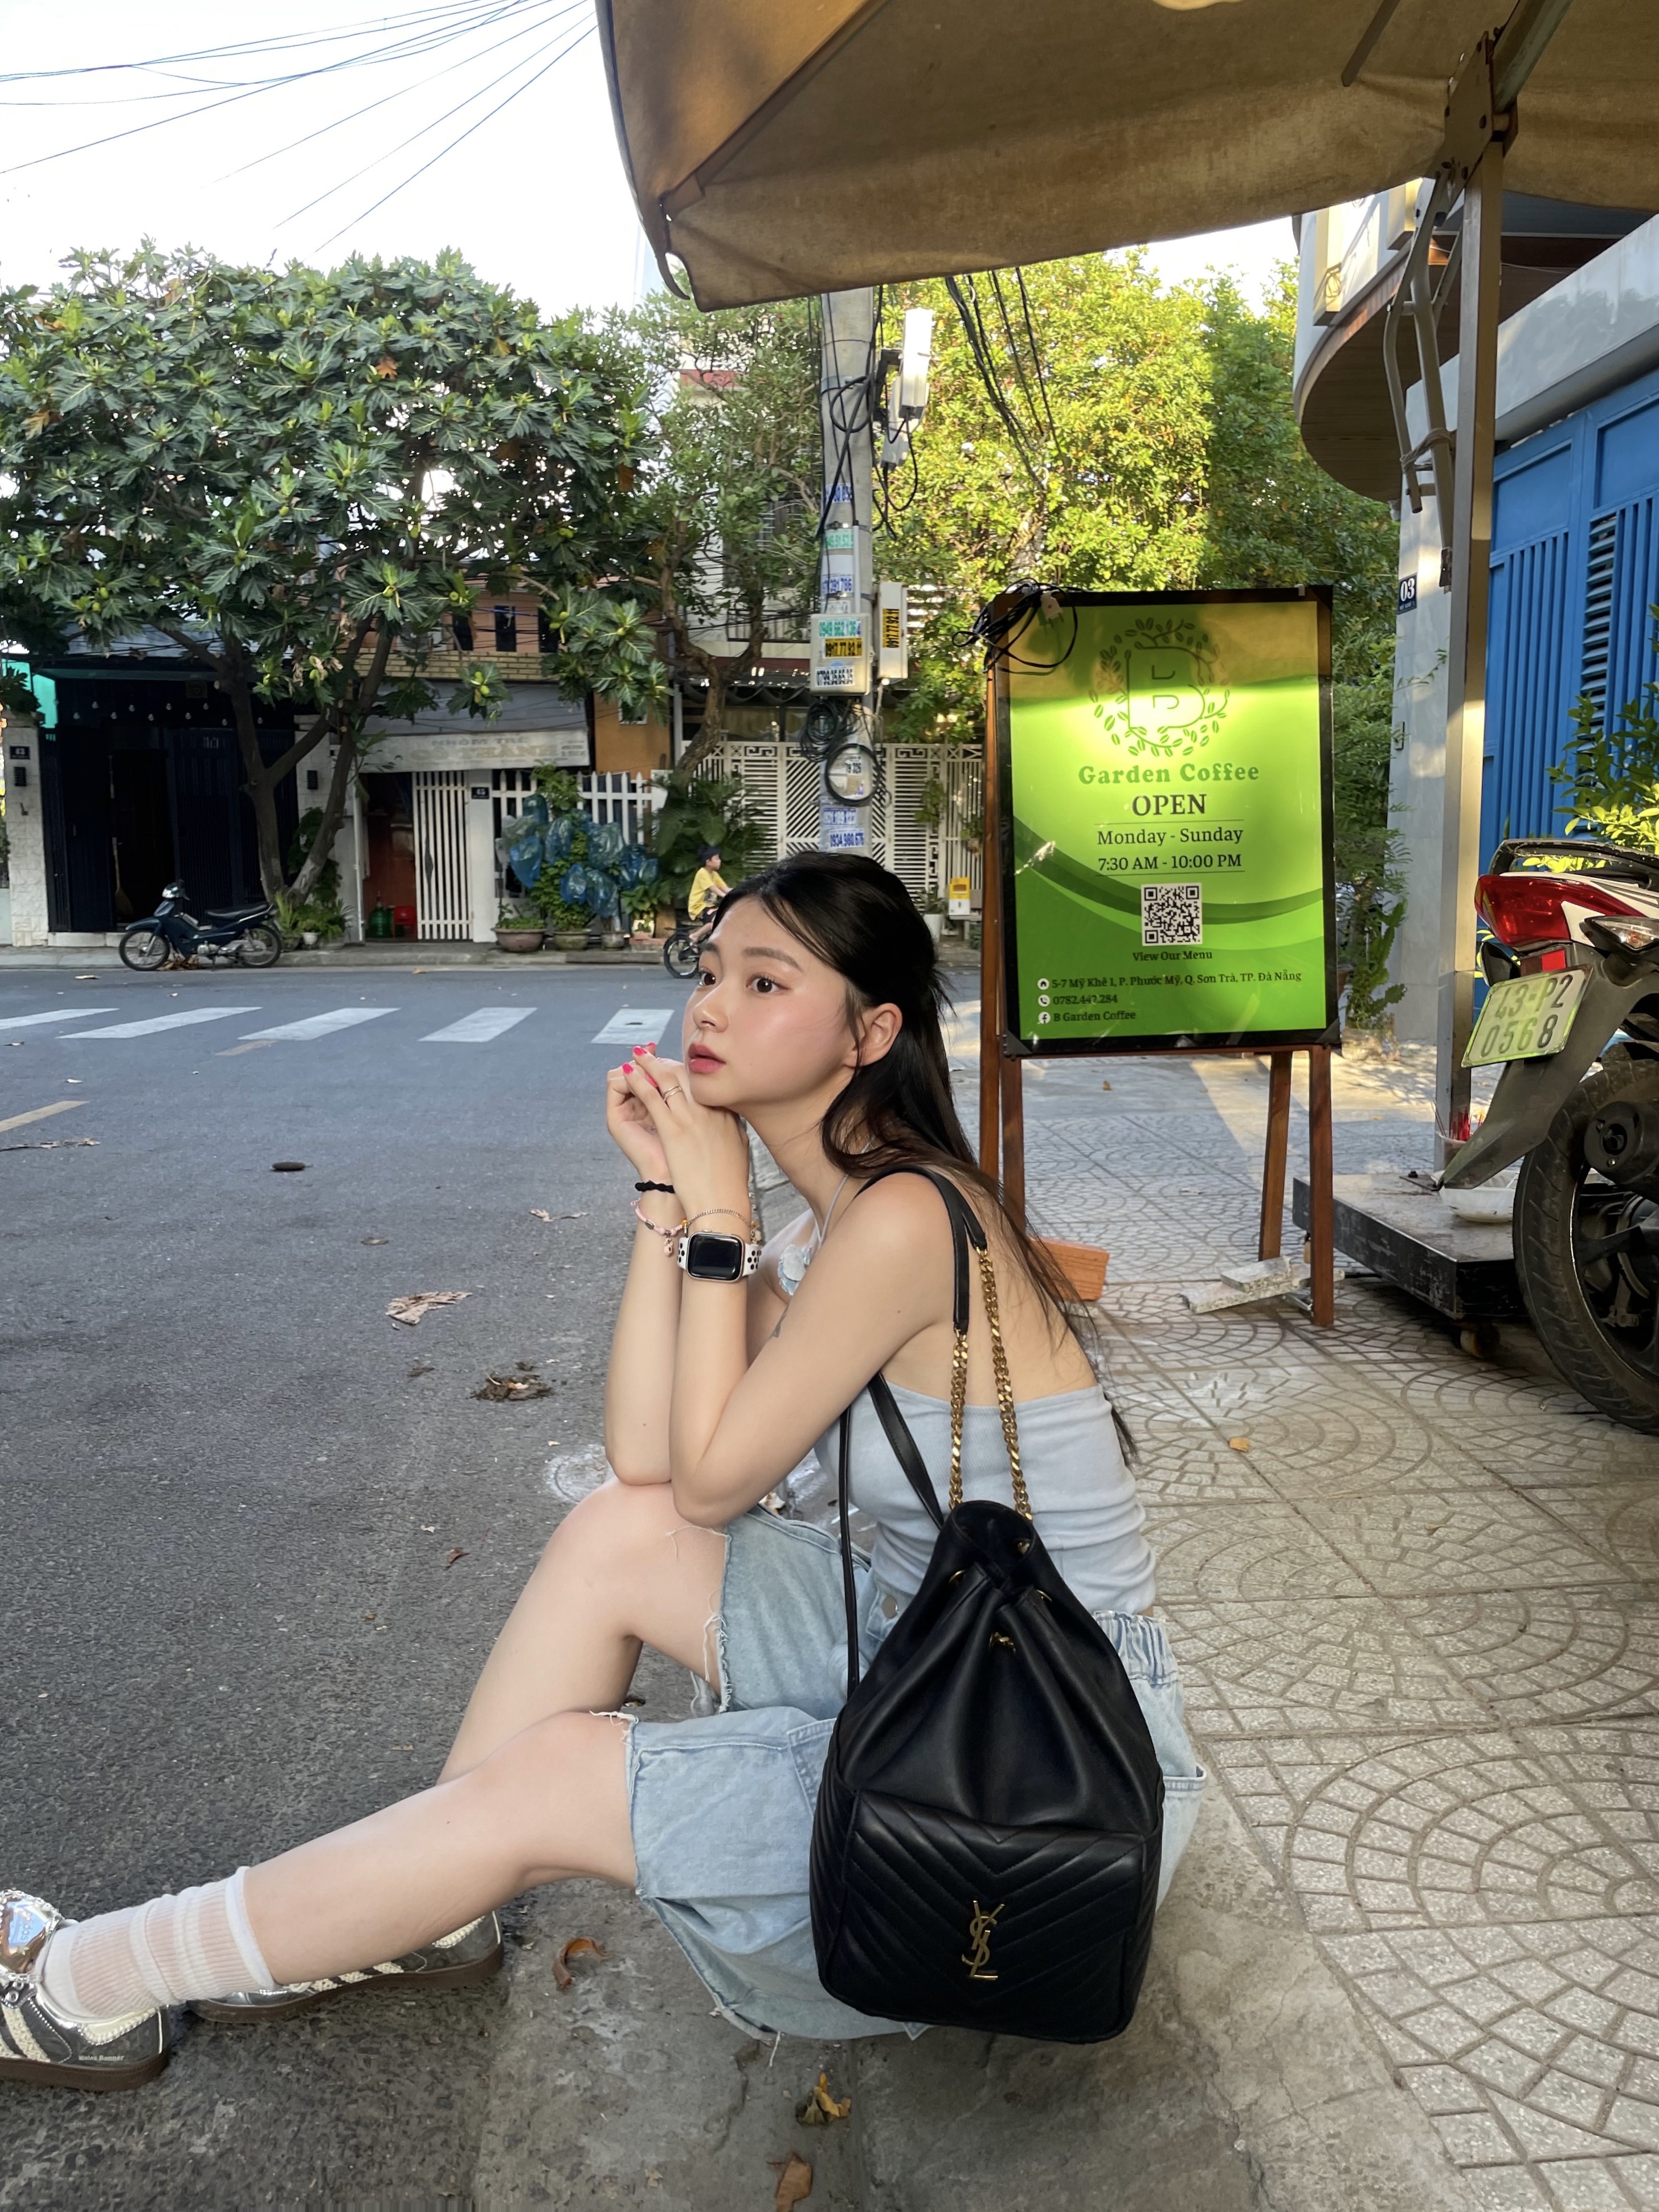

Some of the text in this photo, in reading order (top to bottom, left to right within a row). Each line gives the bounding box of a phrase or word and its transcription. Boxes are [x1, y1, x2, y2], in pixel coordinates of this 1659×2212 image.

[1400, 578, 1415, 602] 03
[1078, 763, 1259, 784] Garden Coffee
[1132, 794, 1207, 816] OPEN
[1097, 829, 1167, 846] Monday
[1180, 827, 1244, 844] Sunday
[1098, 857, 1129, 871] 7:30
[1132, 856, 1158, 870] AM
[1171, 855, 1213, 869] 10:00
[1217, 854, 1242, 867] PM
[1132, 951, 1212, 961] View Our Menu
[1069, 978, 1085, 990] Mỹ
[1087, 978, 1108, 987] Khê
[1119, 977, 1128, 986] P.
[1184, 975, 1195, 984] Q.
[1197, 974, 1216, 983] Sơn
[1240, 973, 1256, 982] TP.
[1258, 971, 1272, 981] Đà
[1274, 970, 1302, 982] Nẵng
[1495, 974, 1574, 1019] 43-P2
[1053, 1011, 1136, 1021] B Garden Coffee
[1481, 1014, 1558, 1057] 0568
